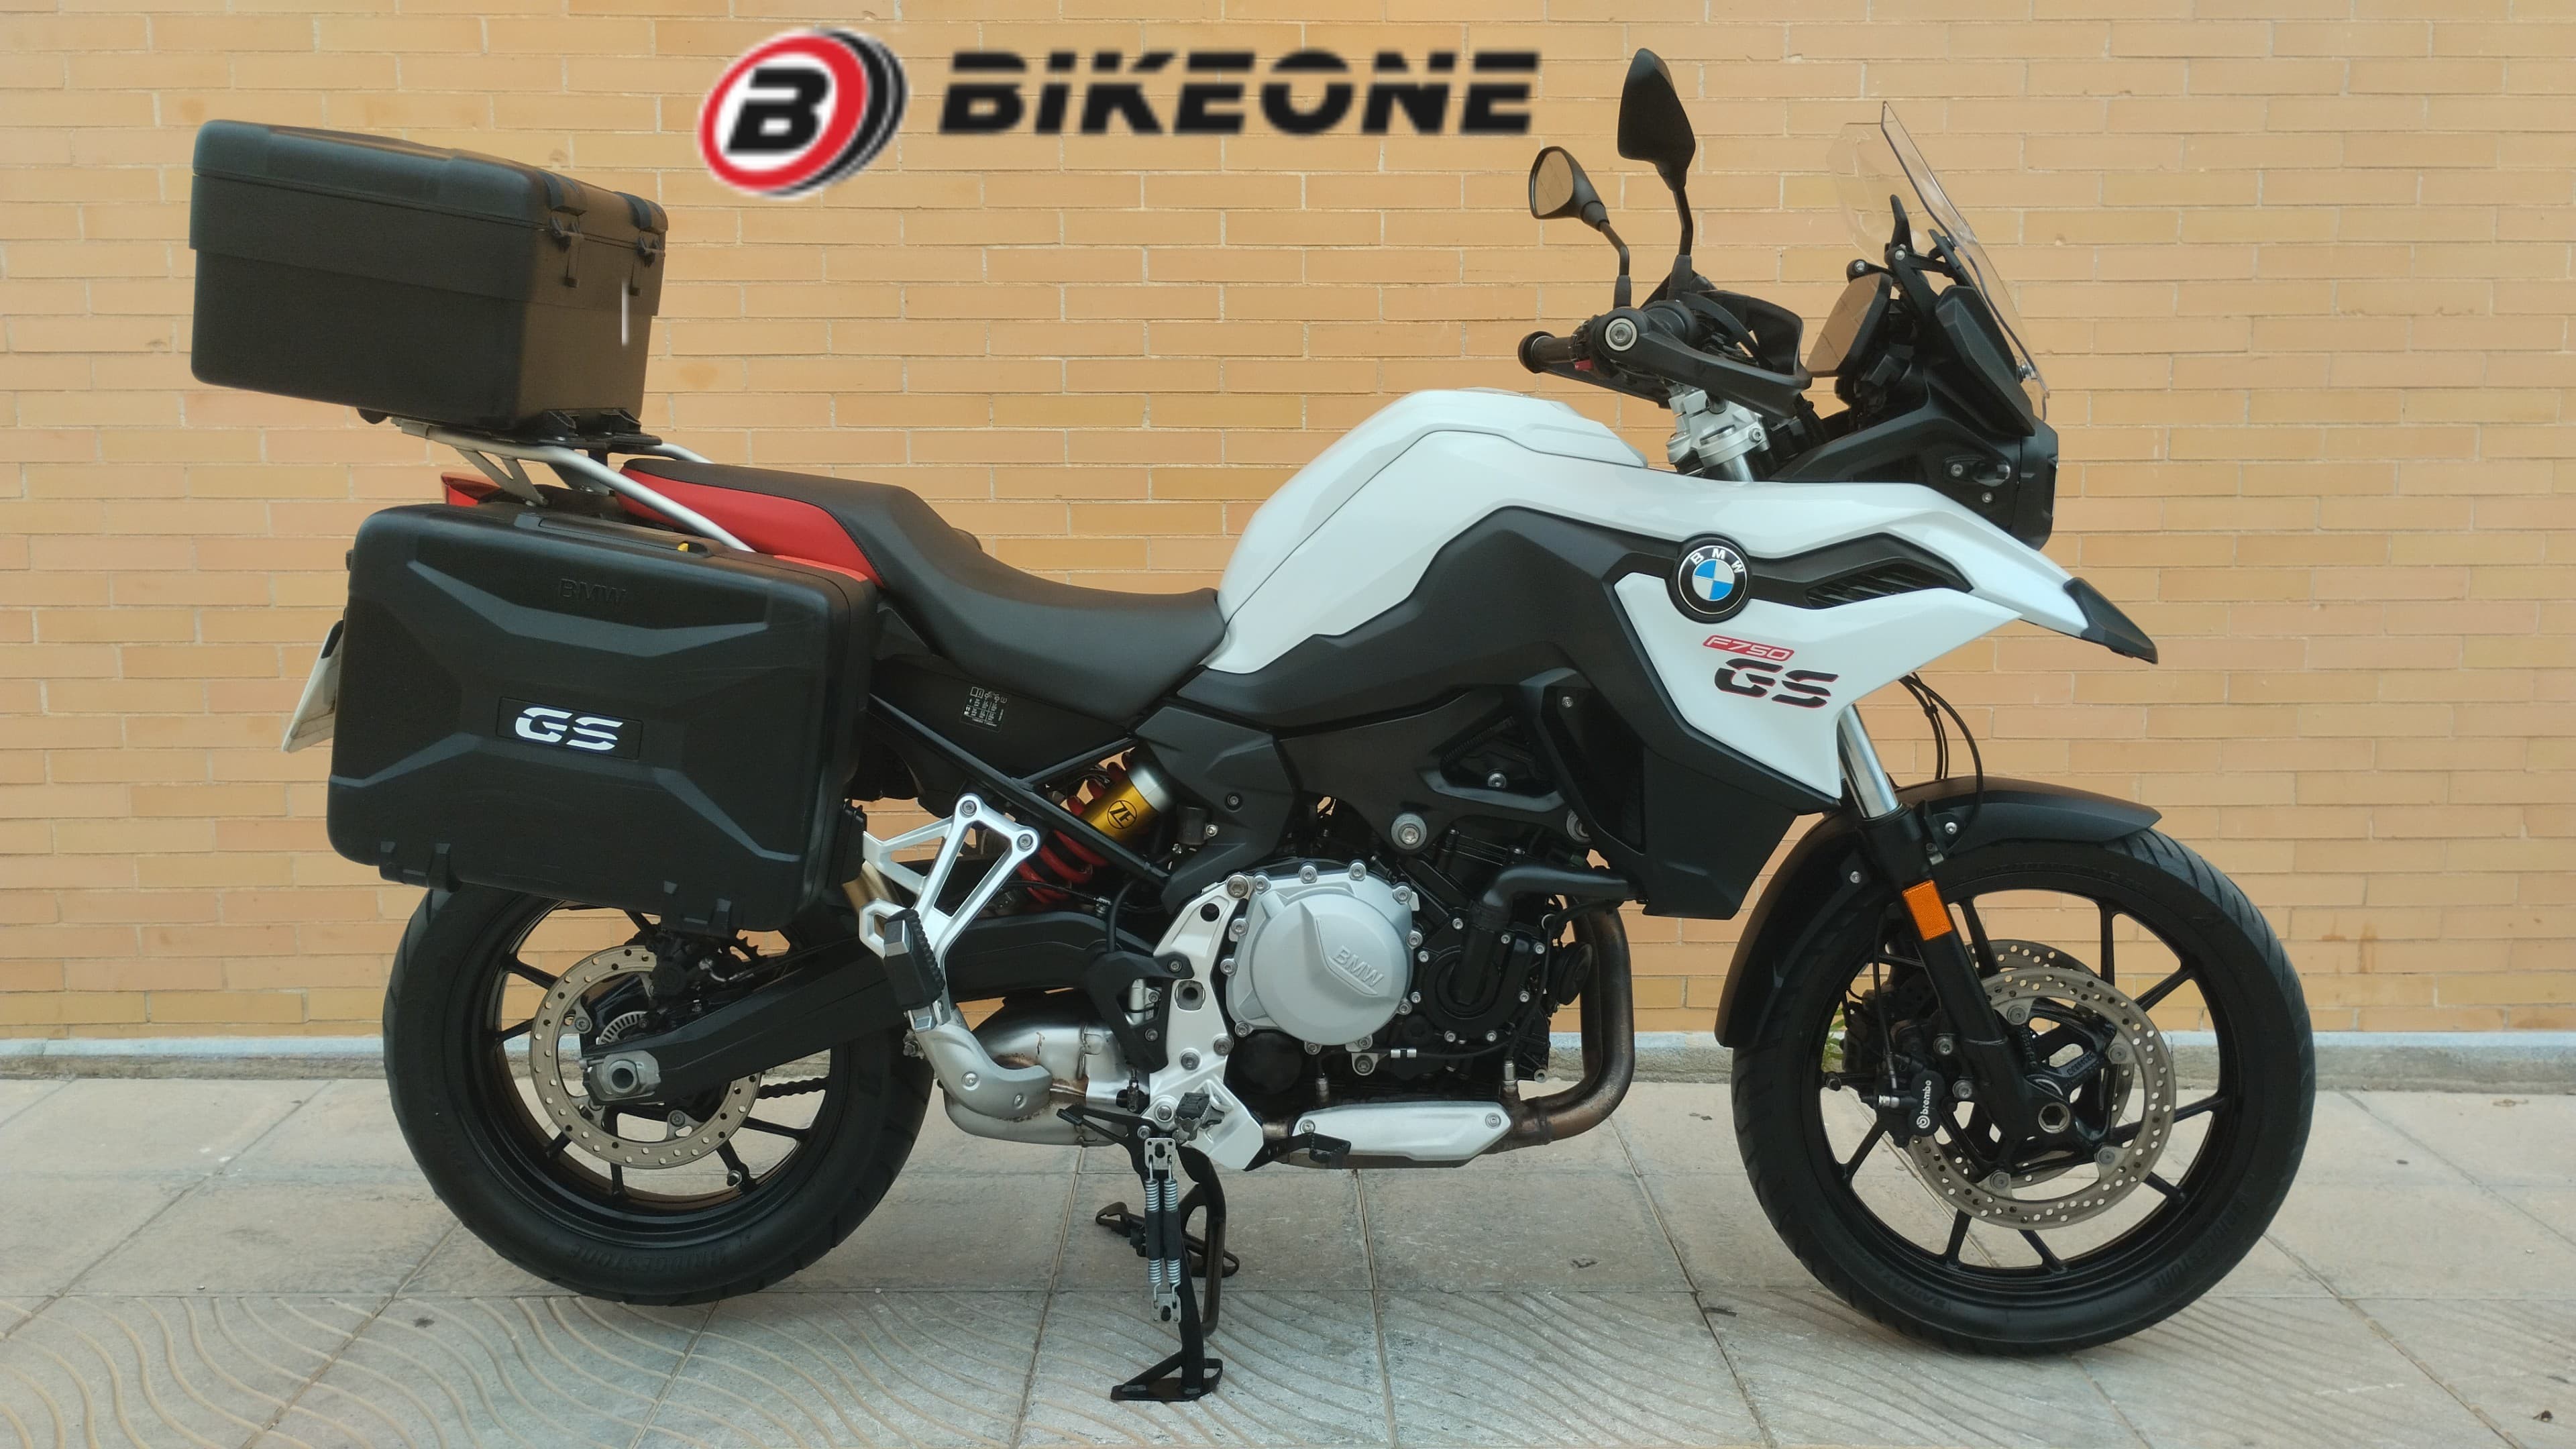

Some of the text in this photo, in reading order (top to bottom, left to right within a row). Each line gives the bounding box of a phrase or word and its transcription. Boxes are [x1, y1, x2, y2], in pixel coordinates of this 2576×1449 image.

[1690, 547, 1744, 574] BMW
[559, 578, 627, 605] BMW
[1707, 637, 1791, 661] F750
[1715, 658, 1839, 708] GS
[515, 707, 624, 751] GS
[1108, 800, 1137, 829] ZF
[1332, 945, 1385, 987] BMW
[1920, 1079, 1932, 1115] brembo
